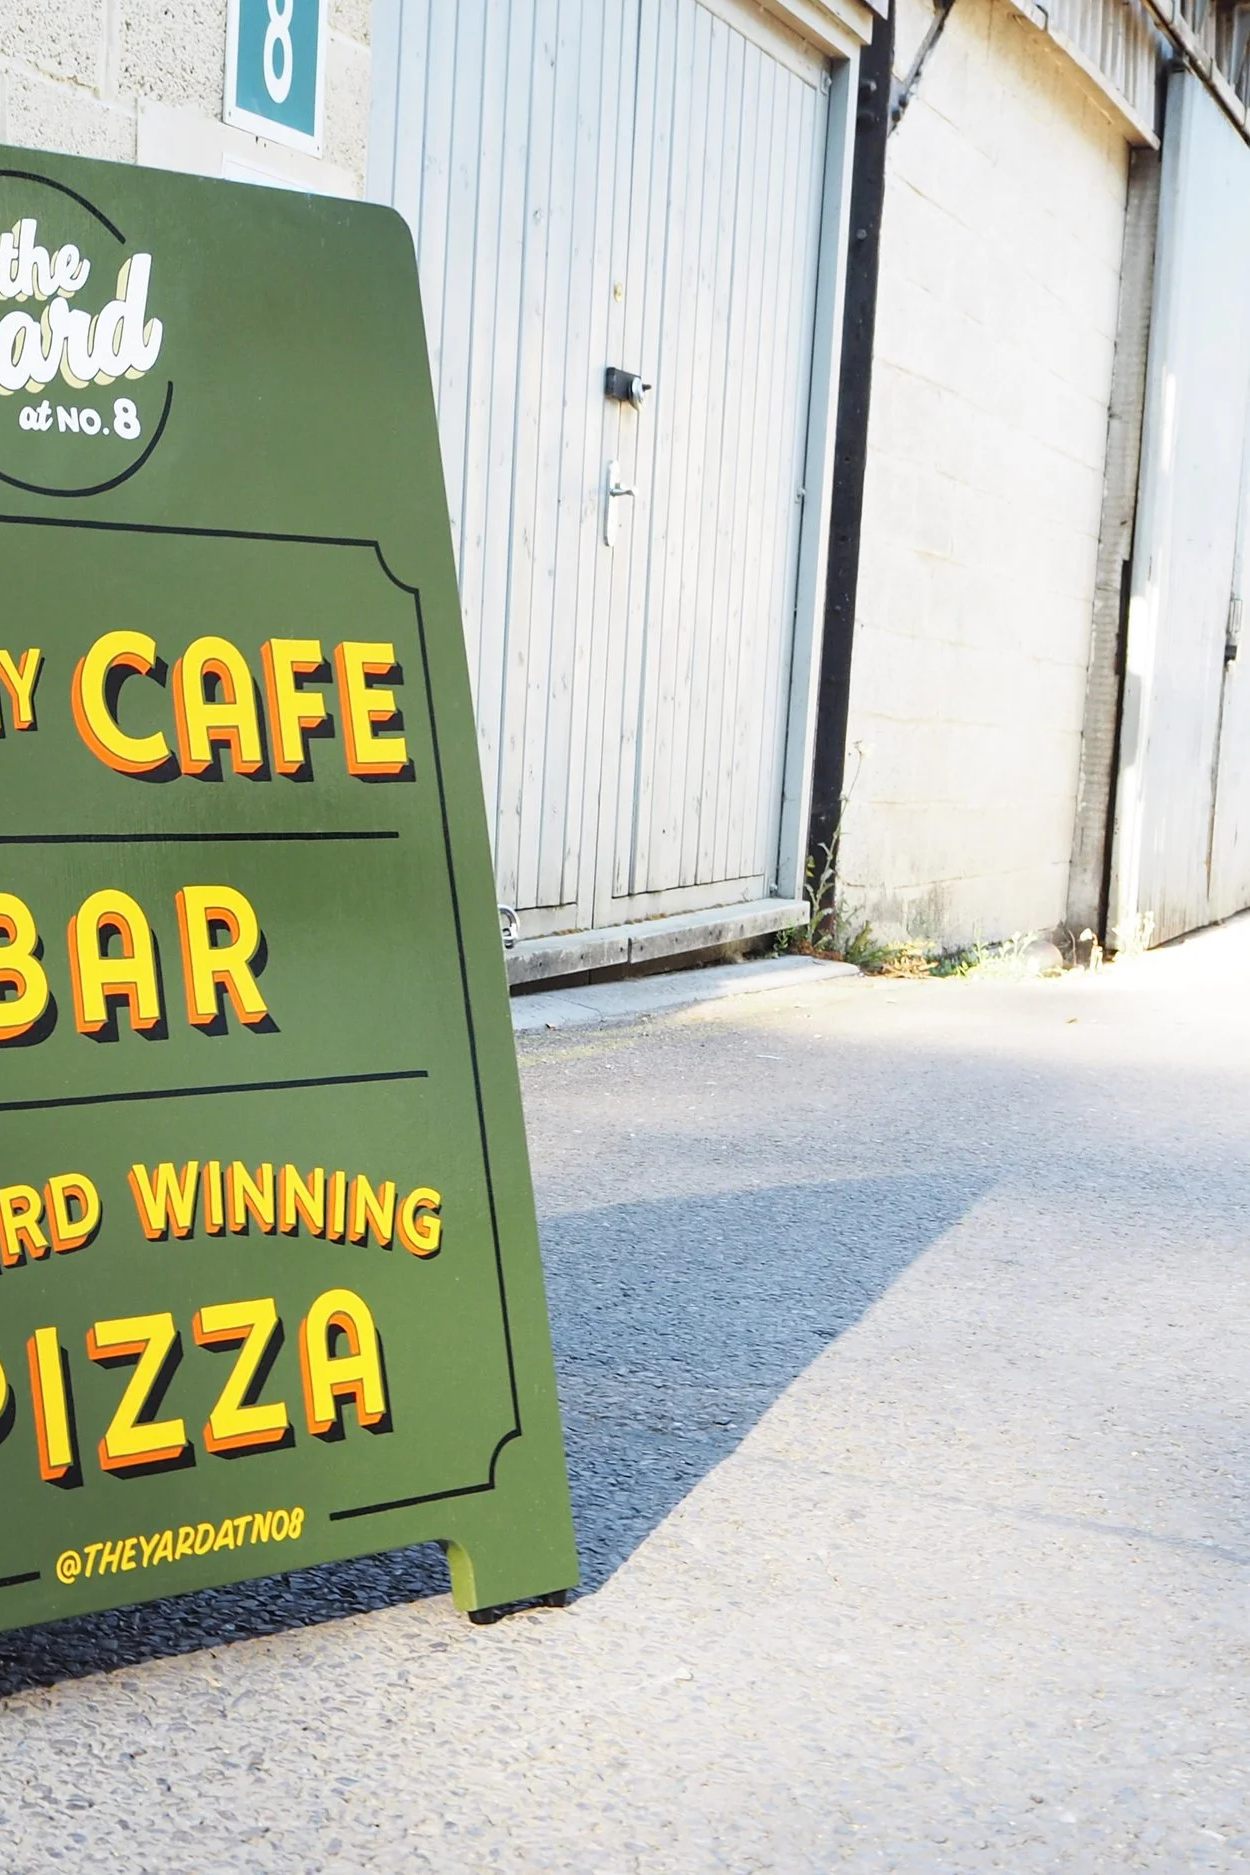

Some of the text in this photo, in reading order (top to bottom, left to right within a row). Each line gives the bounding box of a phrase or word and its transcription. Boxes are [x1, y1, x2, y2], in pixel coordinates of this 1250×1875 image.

[19, 400, 53, 431] at
[71, 630, 416, 783] CAFE
[129, 1160, 443, 1260] WINNING
[55, 1506, 305, 1585] @THEYARDATNO8
